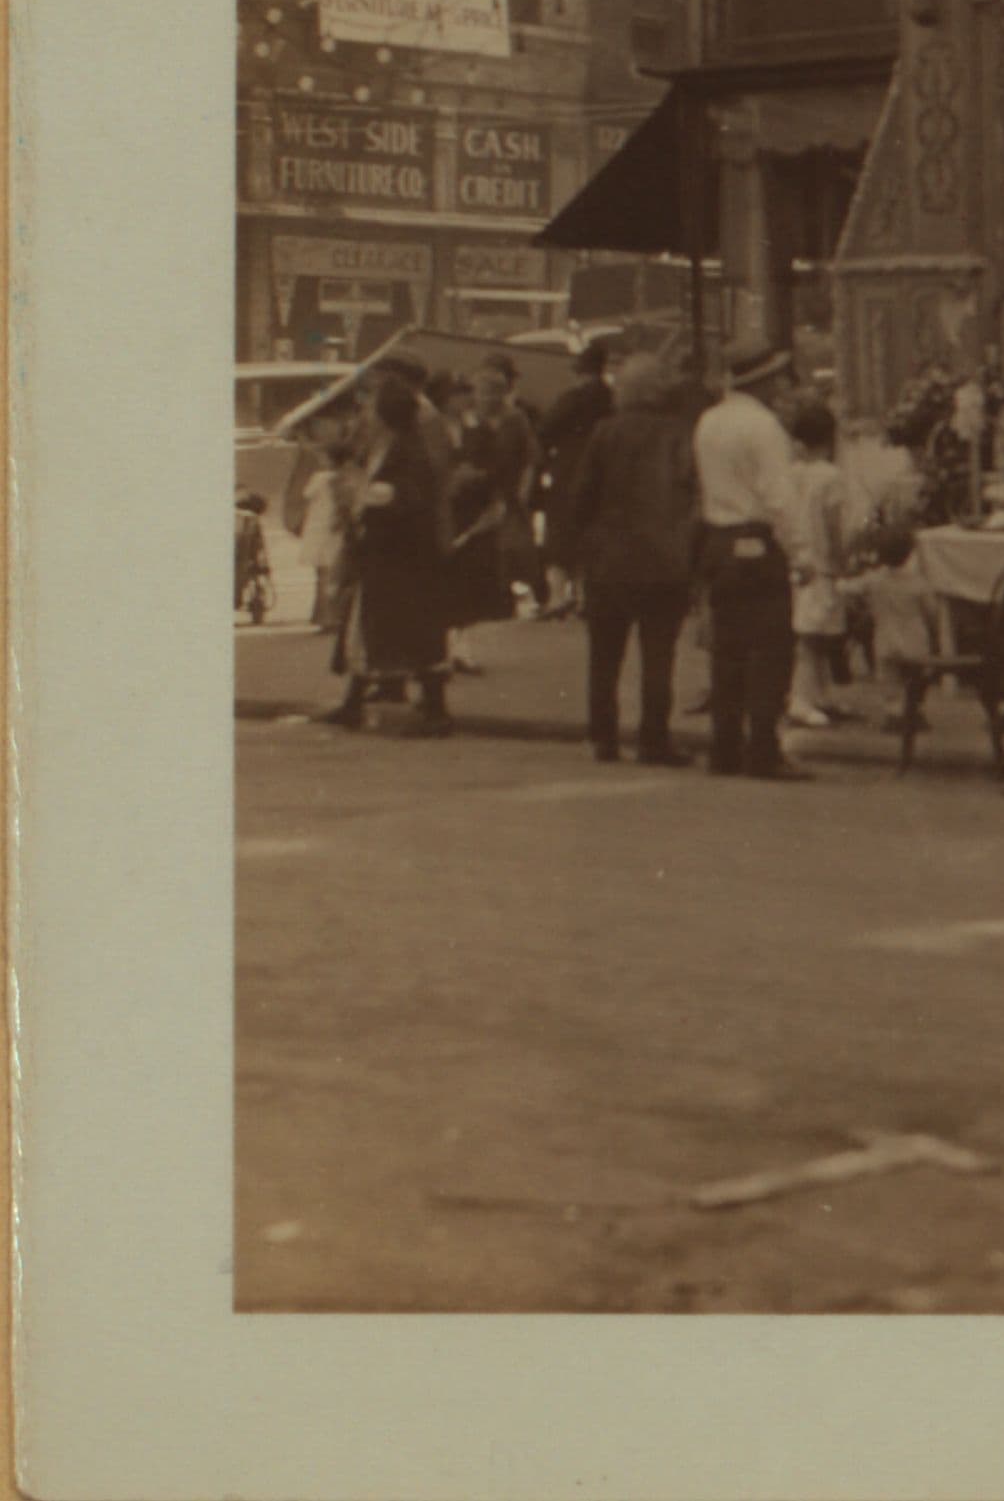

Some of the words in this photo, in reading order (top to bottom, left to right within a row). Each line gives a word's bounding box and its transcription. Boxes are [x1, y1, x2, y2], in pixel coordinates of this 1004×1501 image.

[280, 110, 349, 149] WEST
[364, 119, 424, 157] SIDE
[464, 127, 541, 162] CASH
[279, 155, 395, 198] FURNITURE
[459, 174, 541, 209] CREDIT
